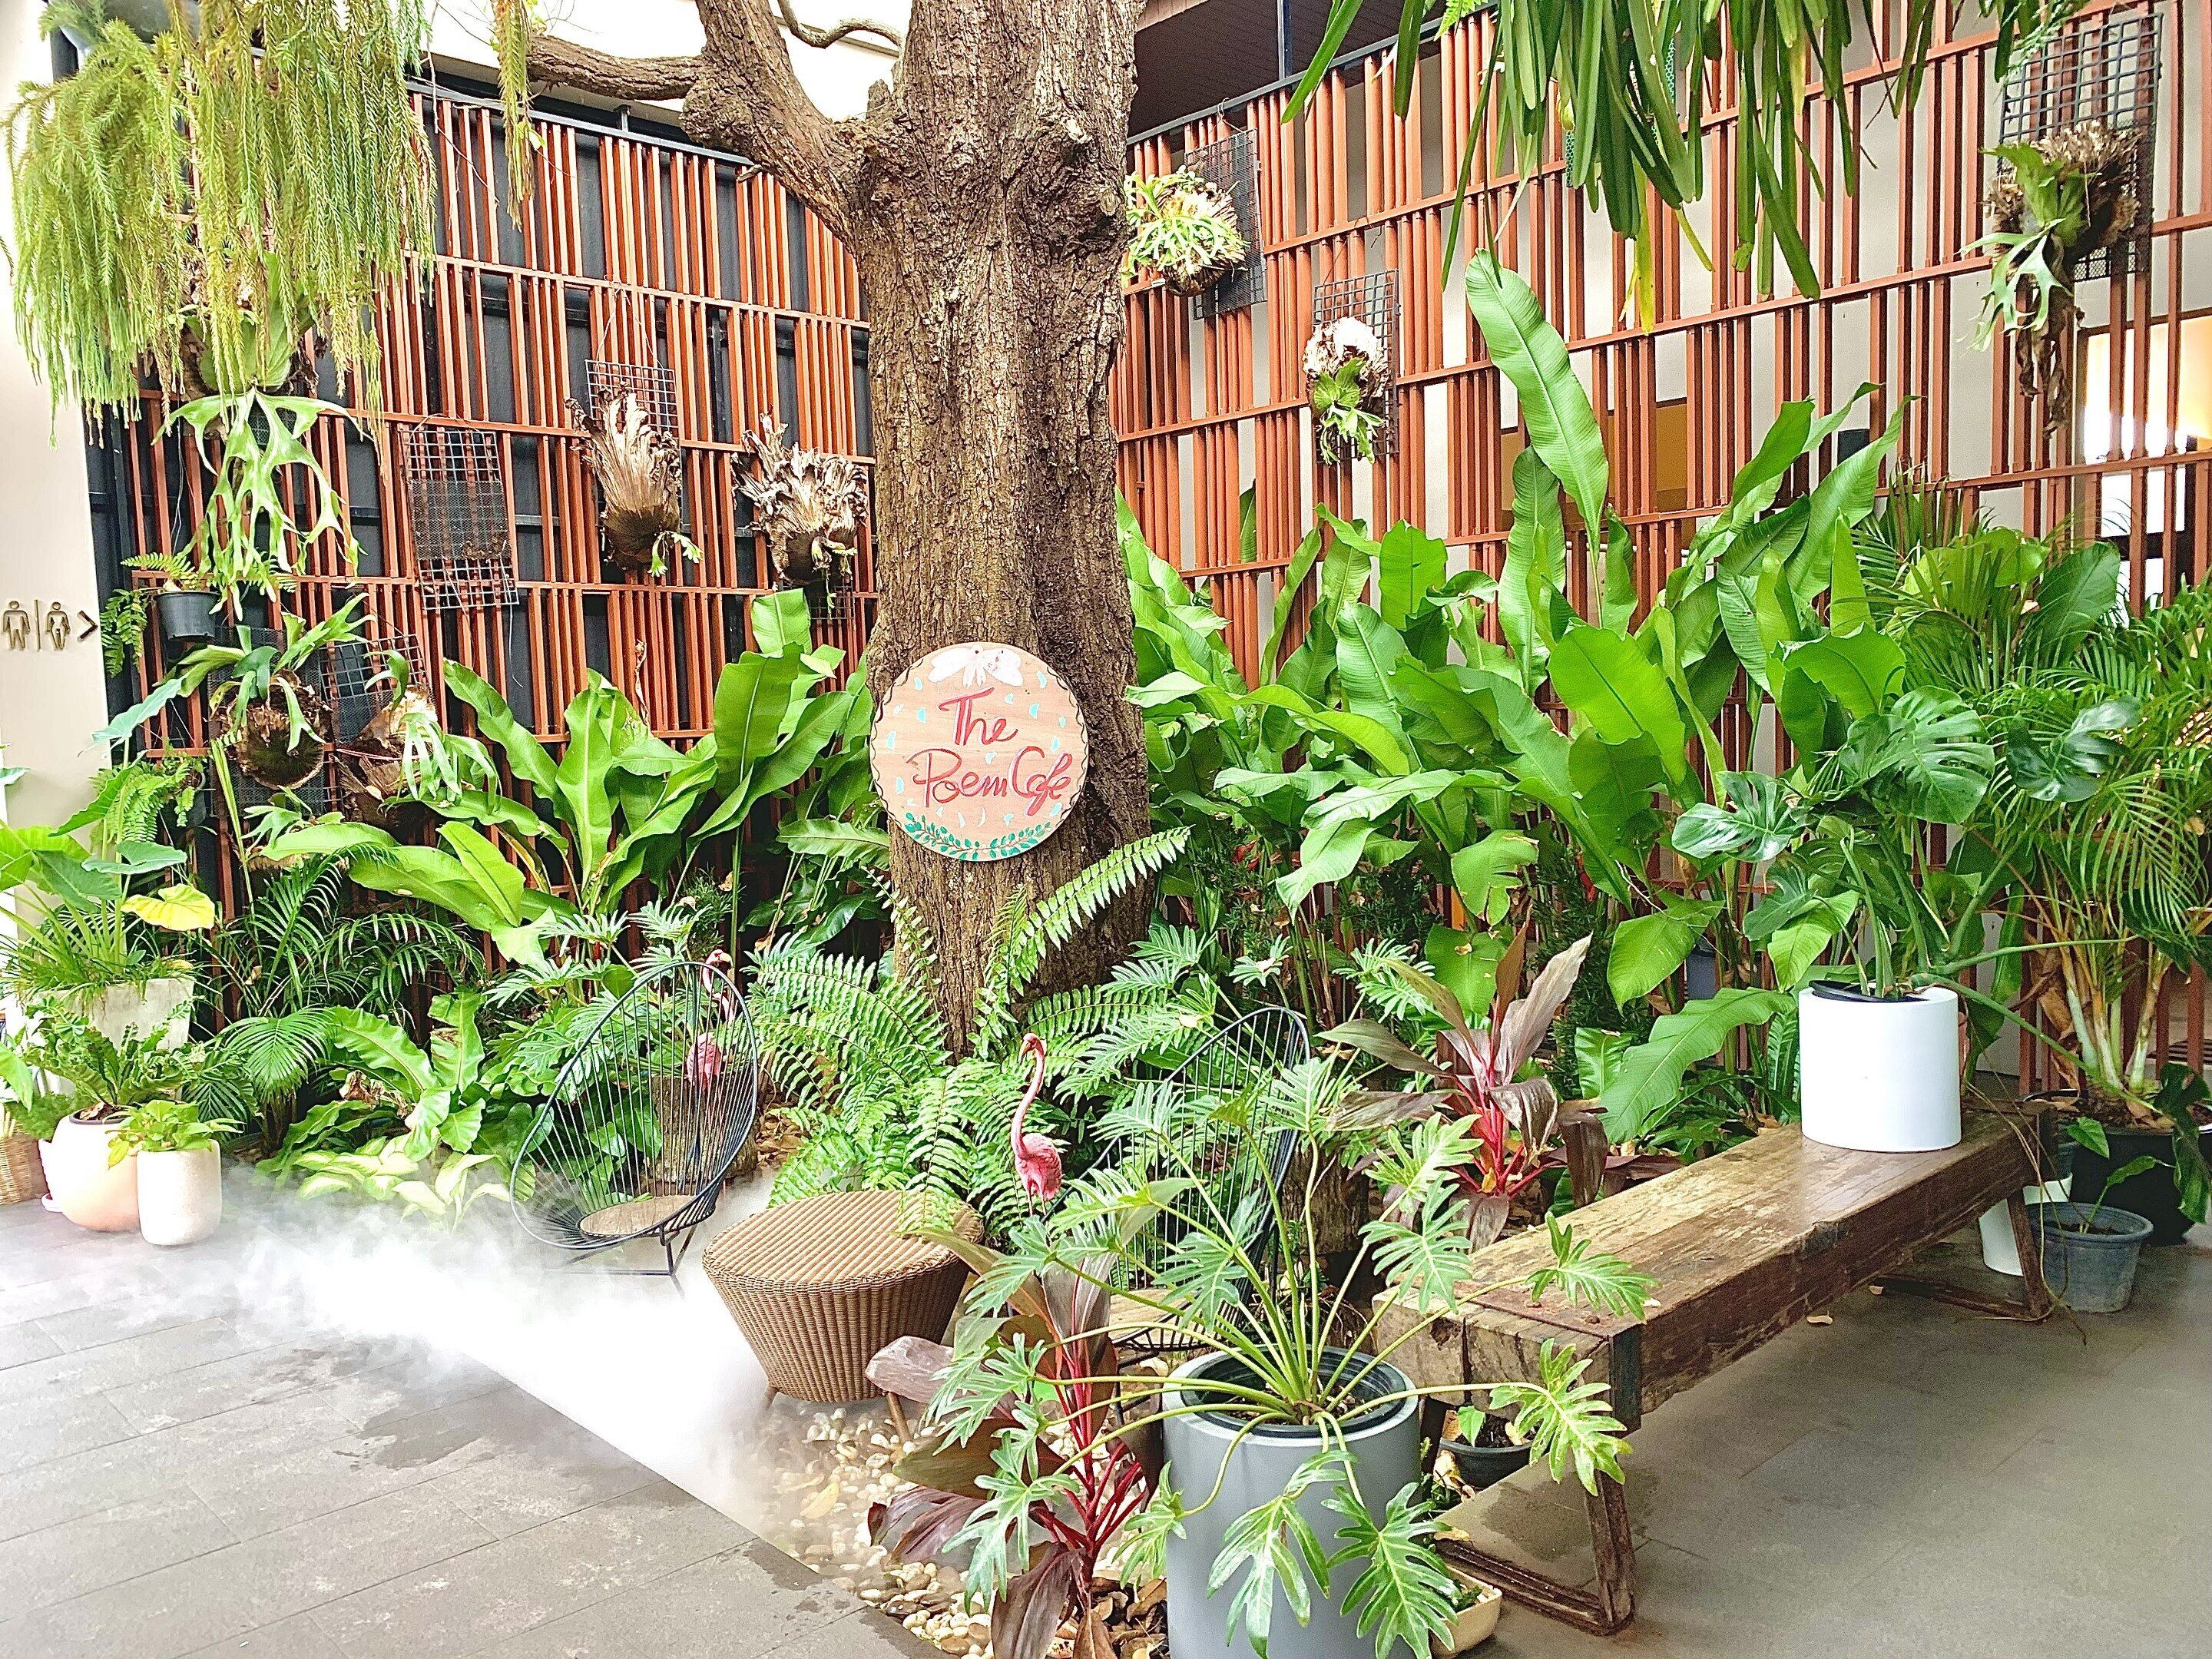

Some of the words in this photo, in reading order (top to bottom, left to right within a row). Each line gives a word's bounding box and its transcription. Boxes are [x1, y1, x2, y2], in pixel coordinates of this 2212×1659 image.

[939, 687, 1018, 746] The
[906, 747, 1008, 808] Poem
[1008, 746, 1073, 816] Cafe
